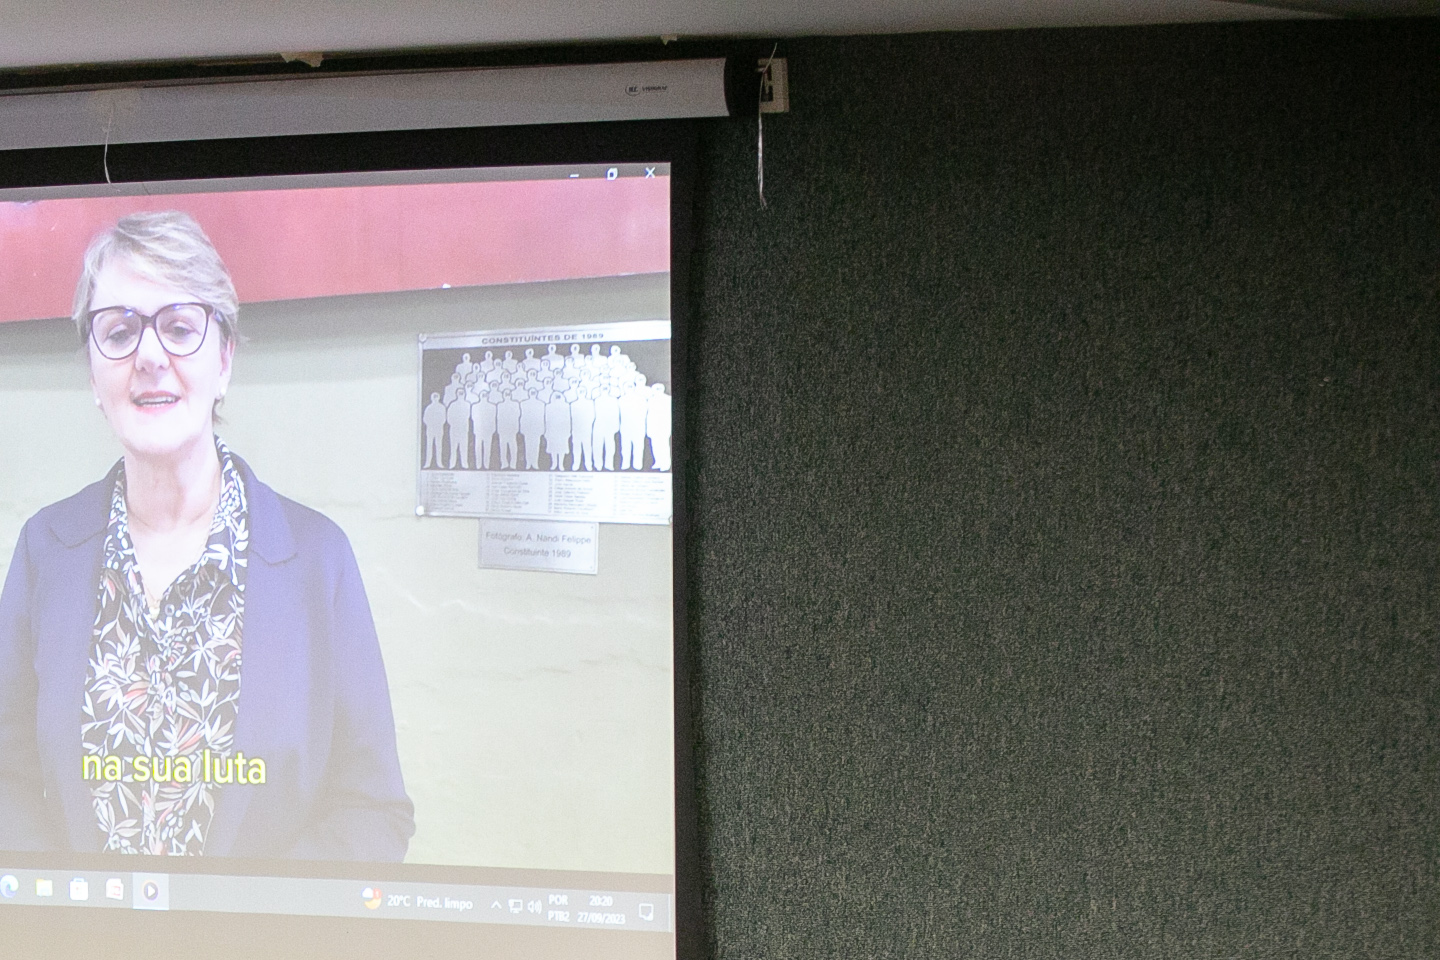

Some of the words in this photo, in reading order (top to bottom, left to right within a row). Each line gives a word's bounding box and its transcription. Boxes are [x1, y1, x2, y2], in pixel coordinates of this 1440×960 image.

[564, 333, 578, 341] DE
[82, 754, 122, 781] na
[133, 755, 192, 782] sua
[203, 749, 266, 784] luta
[416, 895, 443, 909] Pred.
[444, 897, 474, 911] limpo
[548, 894, 569, 906] POR
